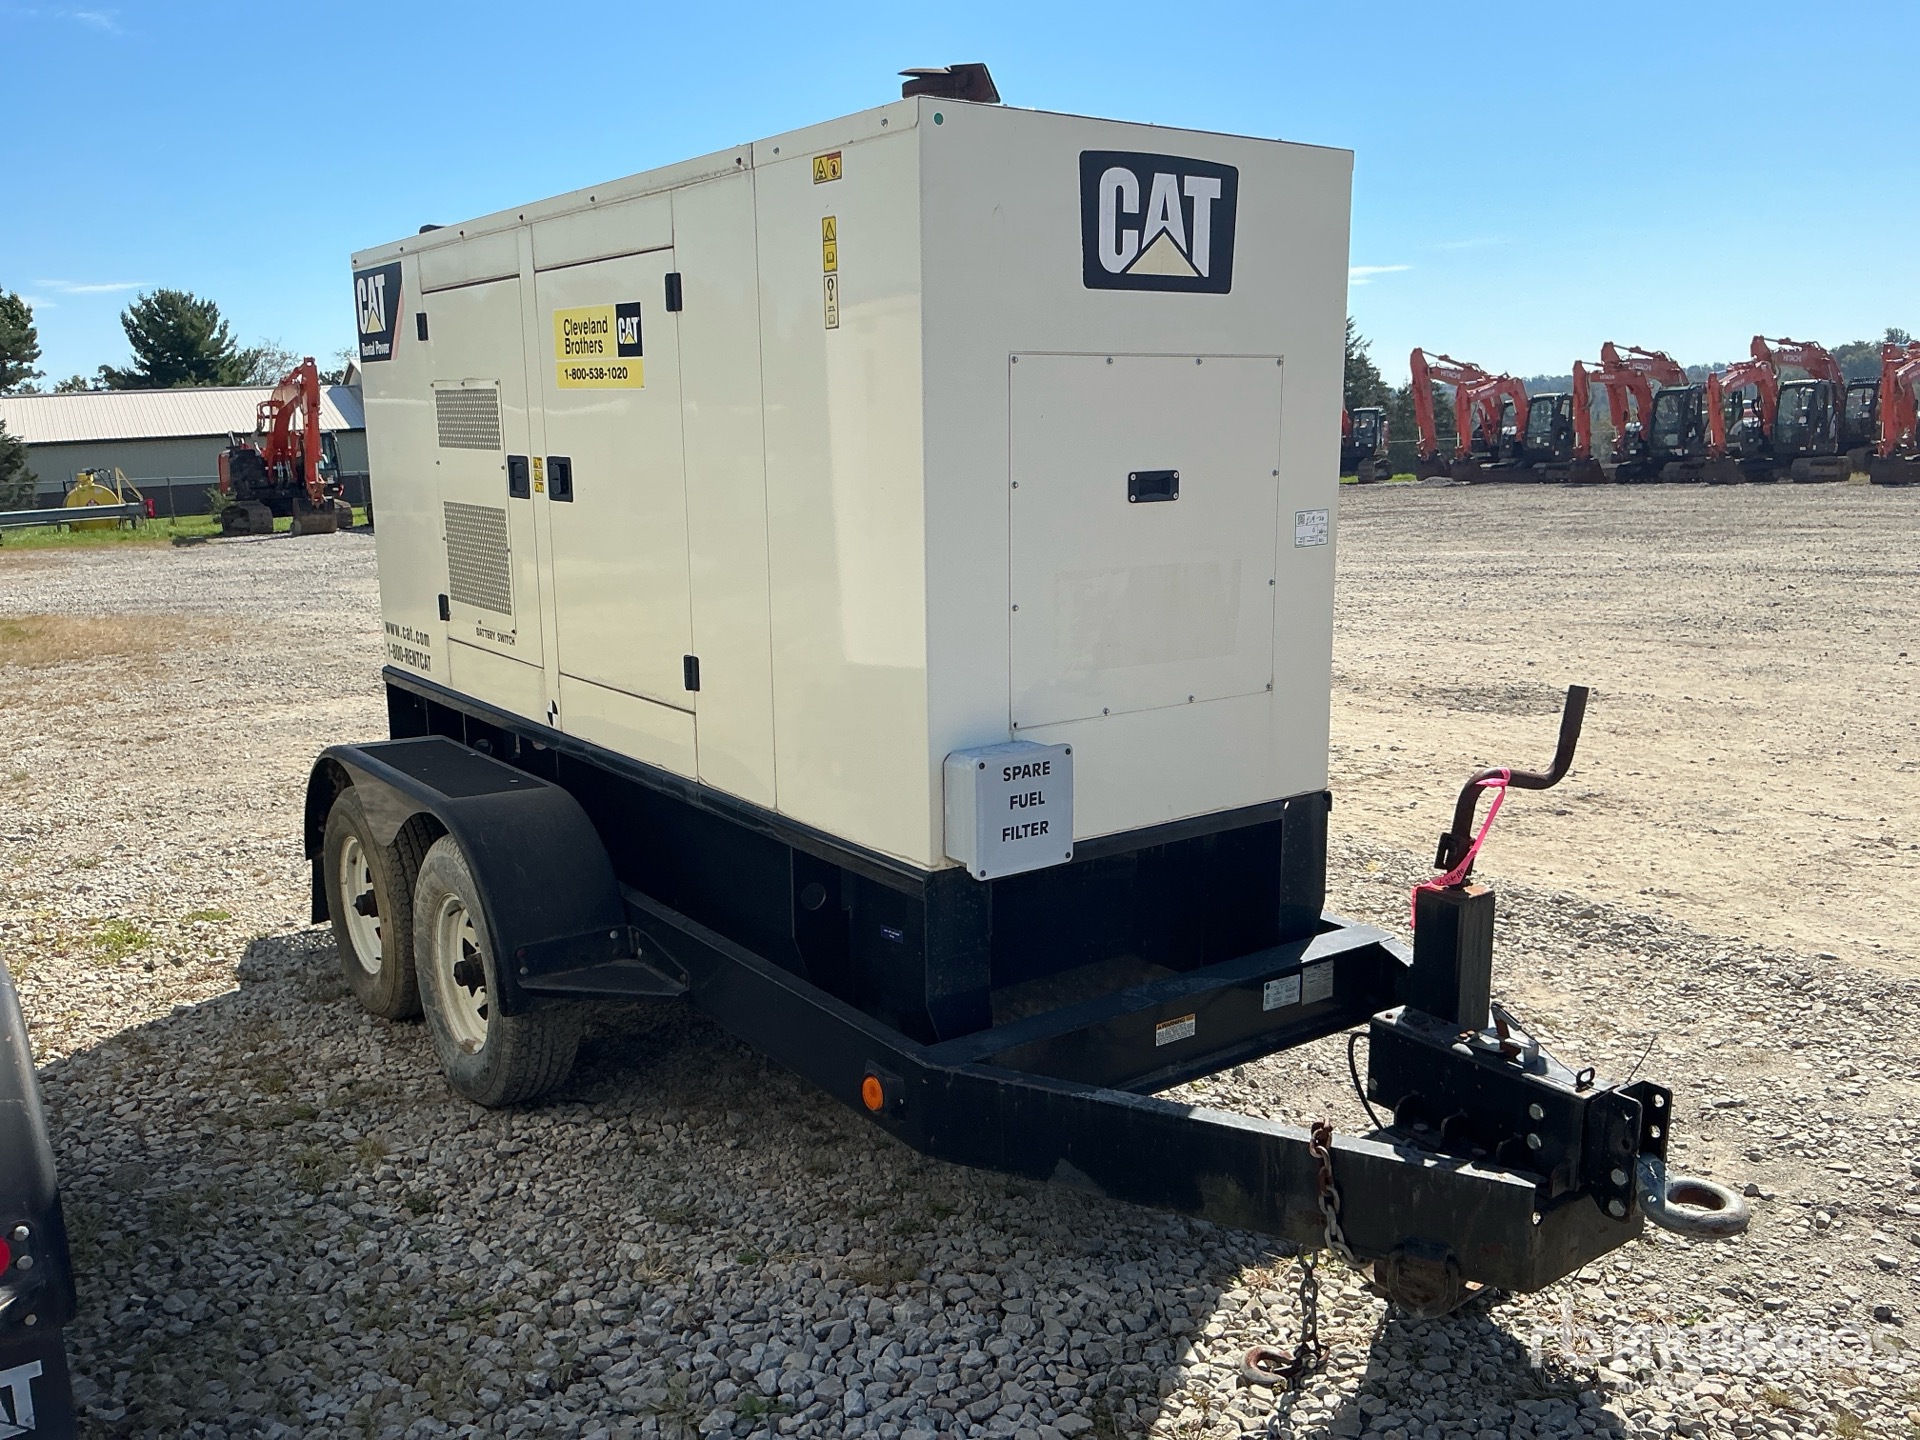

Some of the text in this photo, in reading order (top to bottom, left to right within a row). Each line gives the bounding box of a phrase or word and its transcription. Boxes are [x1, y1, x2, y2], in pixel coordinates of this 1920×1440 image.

[1099, 167, 1221, 278] CAT
[357, 274, 386, 334] CAT
[563, 315, 608, 336] Cleveland
[618, 317, 639, 344] CAT
[565, 337, 603, 355] Brothers
[564, 366, 628, 380] 1-800-538-1020
[385, 621, 430, 648] www.cat.com
[475, 626, 516, 647] BATTERY SWITCH
[386, 642, 431, 672] 1-800-RENTCAT
[1003, 760, 1051, 781] SPARE
[1009, 791, 1045, 810] FUEL
[1002, 820, 1049, 842] FILTER
